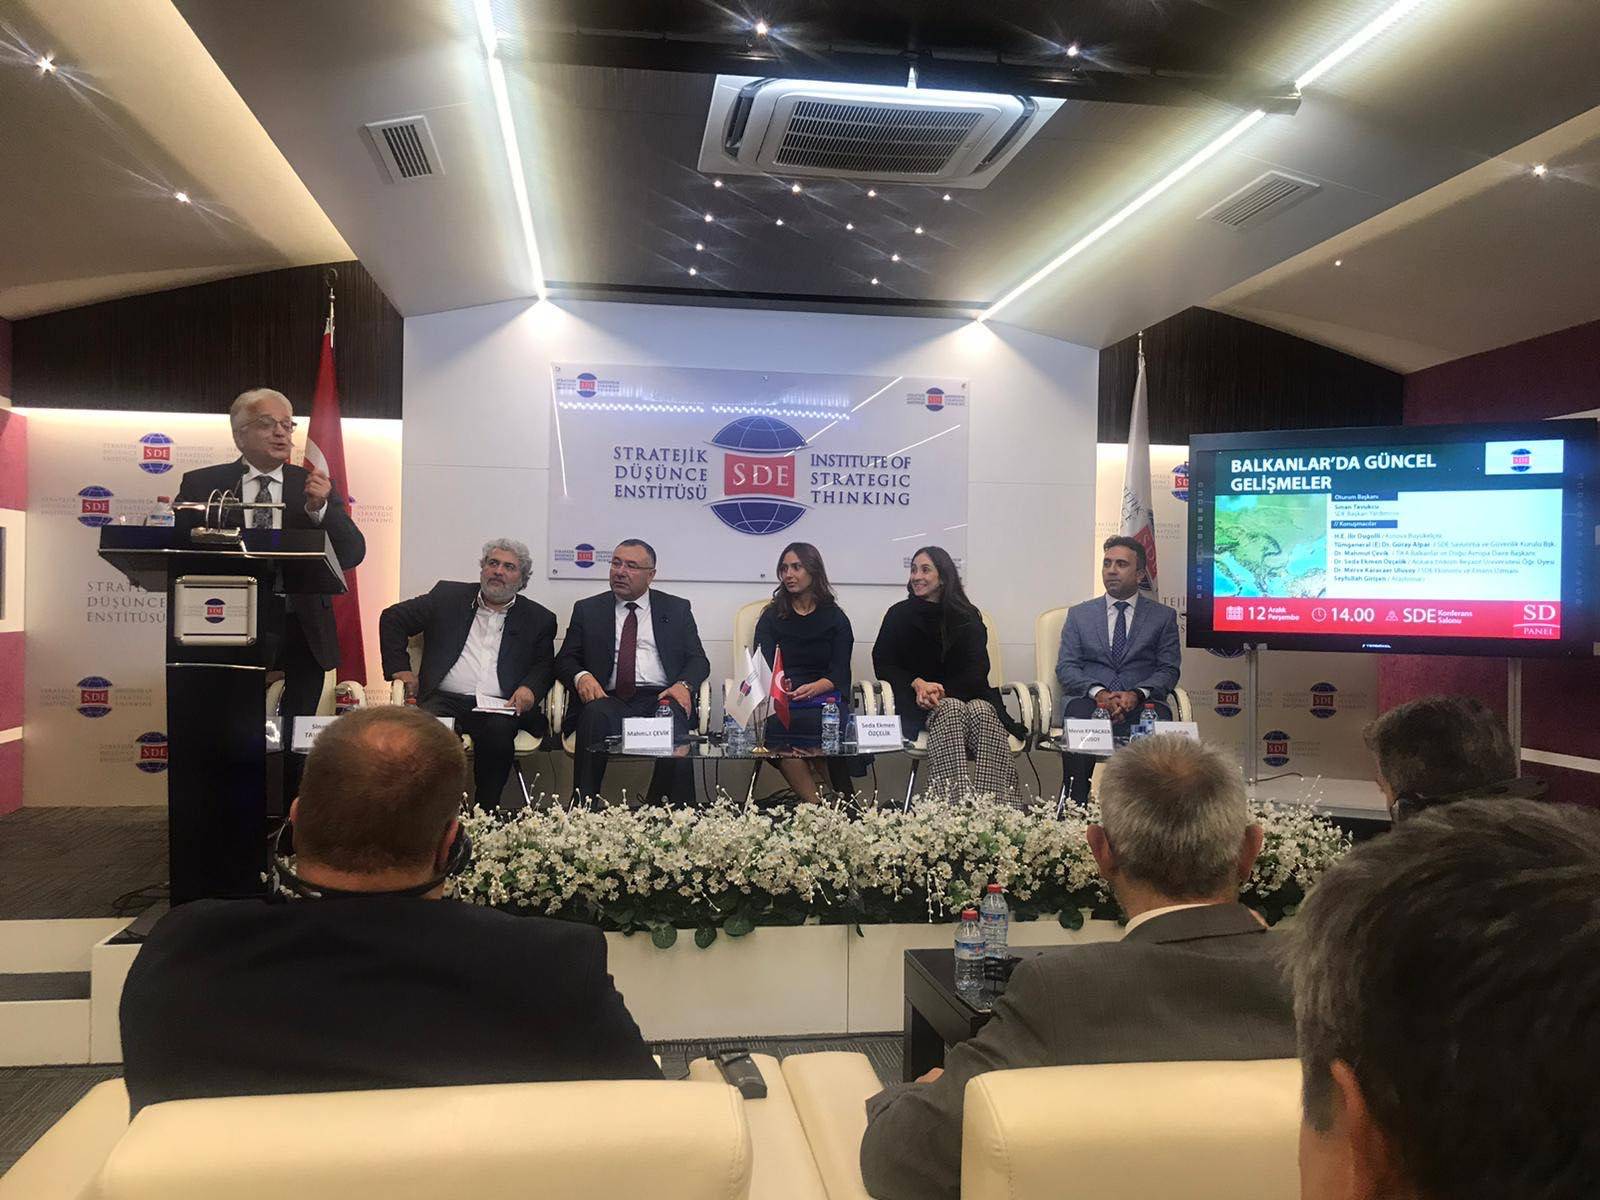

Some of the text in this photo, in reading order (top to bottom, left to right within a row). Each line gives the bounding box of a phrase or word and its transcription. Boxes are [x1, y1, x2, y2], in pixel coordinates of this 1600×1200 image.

[145, 449, 169, 458] SDE
[613, 446, 708, 465] STRATEJİK
[810, 453, 911, 469] INSTITUTE OF
[1364, 452, 1437, 470] GÜNCEL
[615, 463, 707, 483] DÜŞÜNCE
[732, 462, 790, 487] SDE
[810, 472, 911, 488] STRATEGIC
[614, 483, 707, 500] ENSTİTÜSÜ
[1230, 474, 1332, 494] GELİŞMELER
[811, 490, 910, 506] THINKING
[84, 502, 109, 511] SDE
[1248, 606, 1266, 620] 12
[1331, 607, 1375, 623] 14.00
[1403, 607, 1436, 624] SDE
[1523, 603, 1556, 621] SD
[83, 692, 107, 702] SDE
[1219, 695, 1238, 703] SDE
[1314, 696, 1332, 705] SDE
[142, 747, 167, 758] SDE
[1268, 743, 1287, 752] SDE
